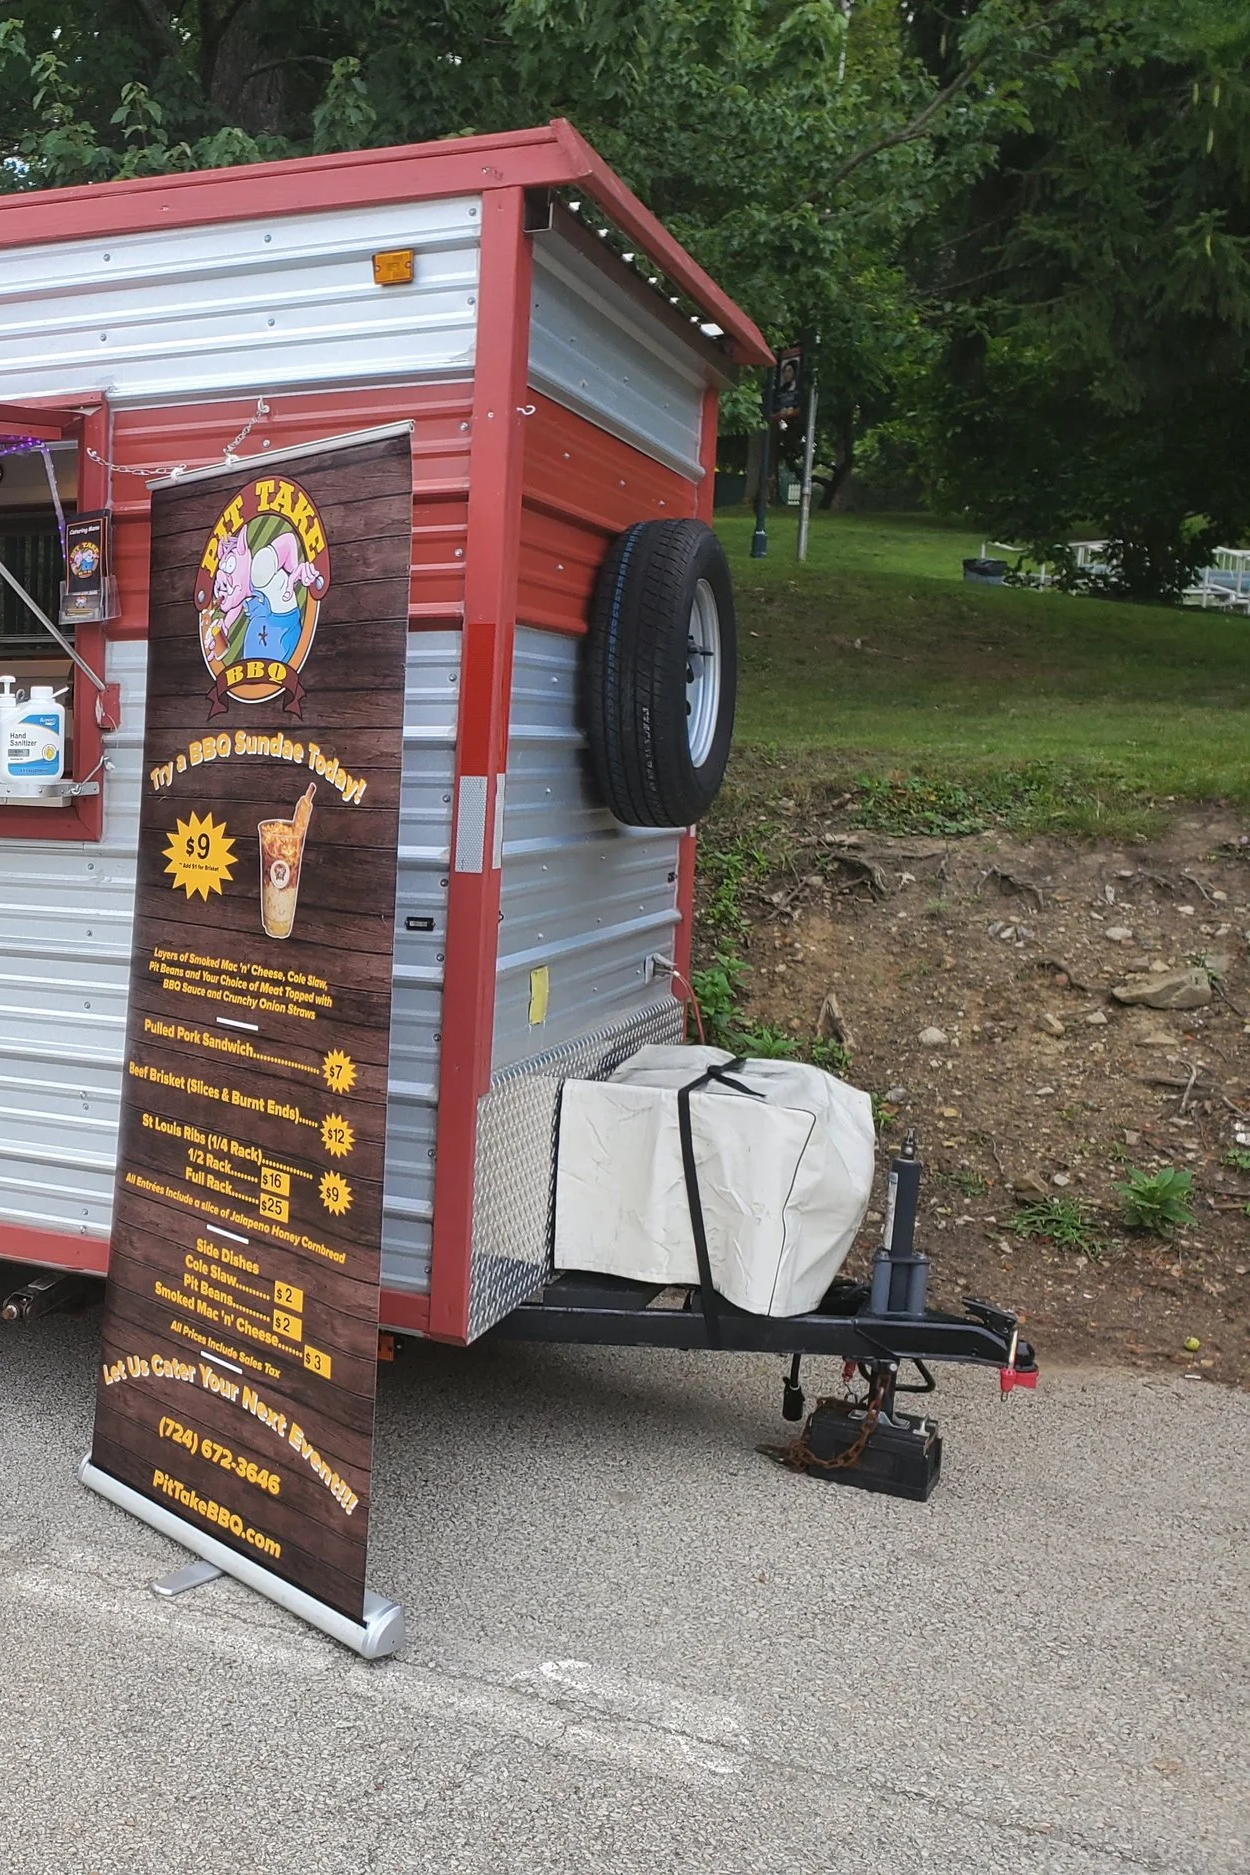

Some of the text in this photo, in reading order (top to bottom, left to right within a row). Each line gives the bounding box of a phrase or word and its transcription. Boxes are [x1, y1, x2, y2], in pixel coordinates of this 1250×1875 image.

[201, 480, 325, 578] PIT TAKE
[226, 662, 287, 686] BBQ
[150, 730, 367, 805] Try a BBQ Sundae Today!
[186, 833, 210, 860] $9
[149, 961, 332, 1007] Pit Beans and Your Choice of Meat Topped with
[154, 948, 178, 961] Layers
[180, 953, 189, 962] of
[189, 954, 220, 969] Smoked
[221, 958, 238, 971] Mac
[251, 965, 285, 982] Cheese,
[287, 971, 306, 984] Cole
[307, 977, 328, 991] Slaw,
[163, 979, 316, 1020] BBQ Sauce and Crunchy Onion Straws
[144, 1019, 174, 1038] Pulled
[177, 1026, 200, 1044] Pork
[330, 1065, 342, 1080] $7
[129, 1062, 149, 1078] Beef
[150, 1067, 185, 1089] Brisket
[187, 1078, 220, 1100] (Slices
[222, 1088, 229, 1102] &
[232, 1091, 265, 1110] Burnt
[328, 1128, 344, 1144] $12
[142, 1114, 153, 1129] St
[155, 1120, 182, 1137] Louis
[184, 1126, 206, 1144] Ribs
[208, 1134, 228, 1153] (1/4
[326, 1187, 338, 1202] $9
[188, 1148, 204, 1164] 1/2
[263, 1174, 281, 1188] $16
[185, 1167, 204, 1184] Full
[261, 1198, 282, 1215] $25
[126, 1172, 135, 1184] All
[166, 1187, 193, 1203] Include
[195, 1200, 200, 1208] a
[201, 1201, 218, 1214] slice
[220, 1208, 230, 1219] of
[272, 1225, 300, 1246] Honey
[302, 1235, 346, 1264] Cornbread
[185, 1255, 208, 1274] Cole
[196, 1239, 260, 1274] Side Dishes
[155, 1282, 195, 1308] Smoked
[197, 1300, 219, 1321] Mac
[184, 1274, 198, 1290] Pit
[170, 1320, 280, 1378] All Prices Include Sales Tax
[103, 1354, 359, 1515] Let Us Cater Your Next Event!!!
[159, 1416, 281, 1495] (724) 672-3646
[153, 1470, 282, 1559] PitTakeBBQ.com
